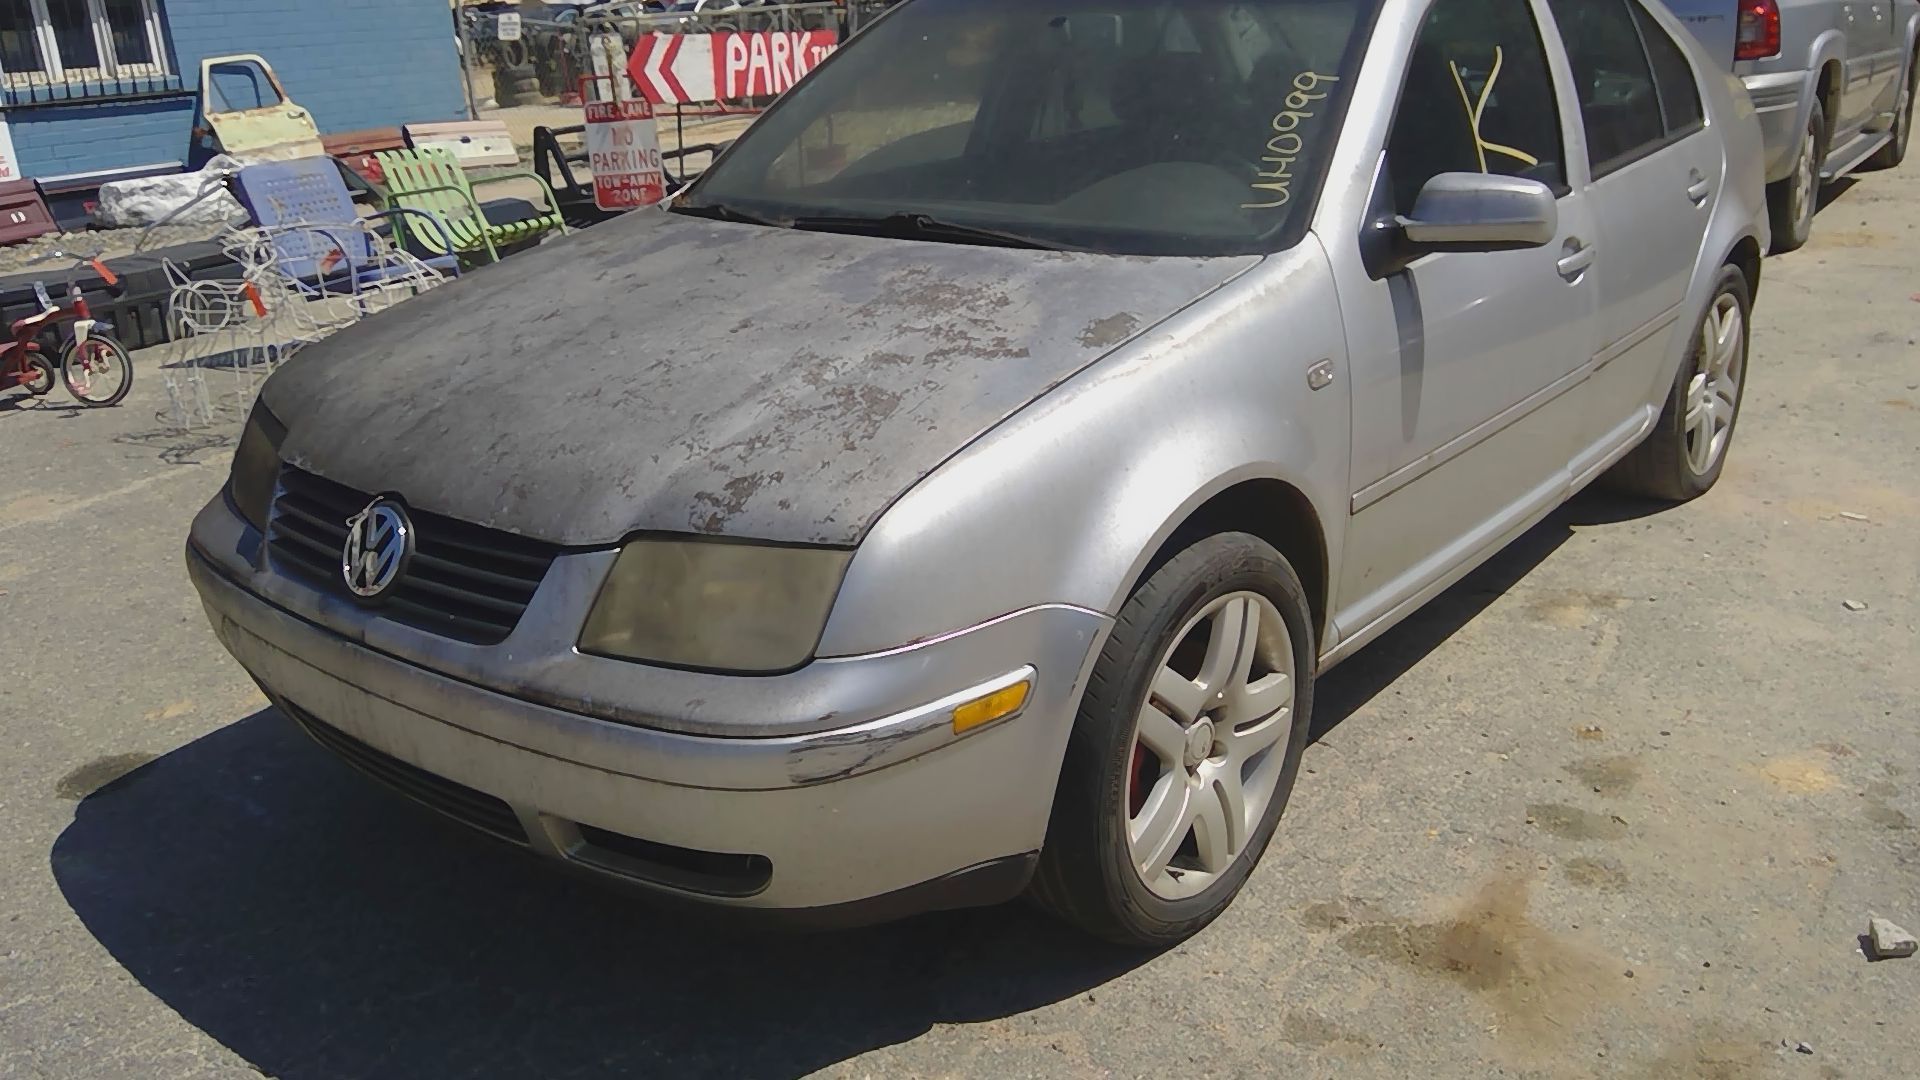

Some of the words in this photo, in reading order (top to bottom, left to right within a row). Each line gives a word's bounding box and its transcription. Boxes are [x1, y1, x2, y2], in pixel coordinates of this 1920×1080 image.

[588, 103, 615, 120] FIRE
[620, 100, 651, 118] LANE
[610, 126, 634, 147] NO
[592, 148, 660, 172] PARKING
[596, 172, 662, 190] TOW-AWAY
[612, 187, 648, 202] ZONE
